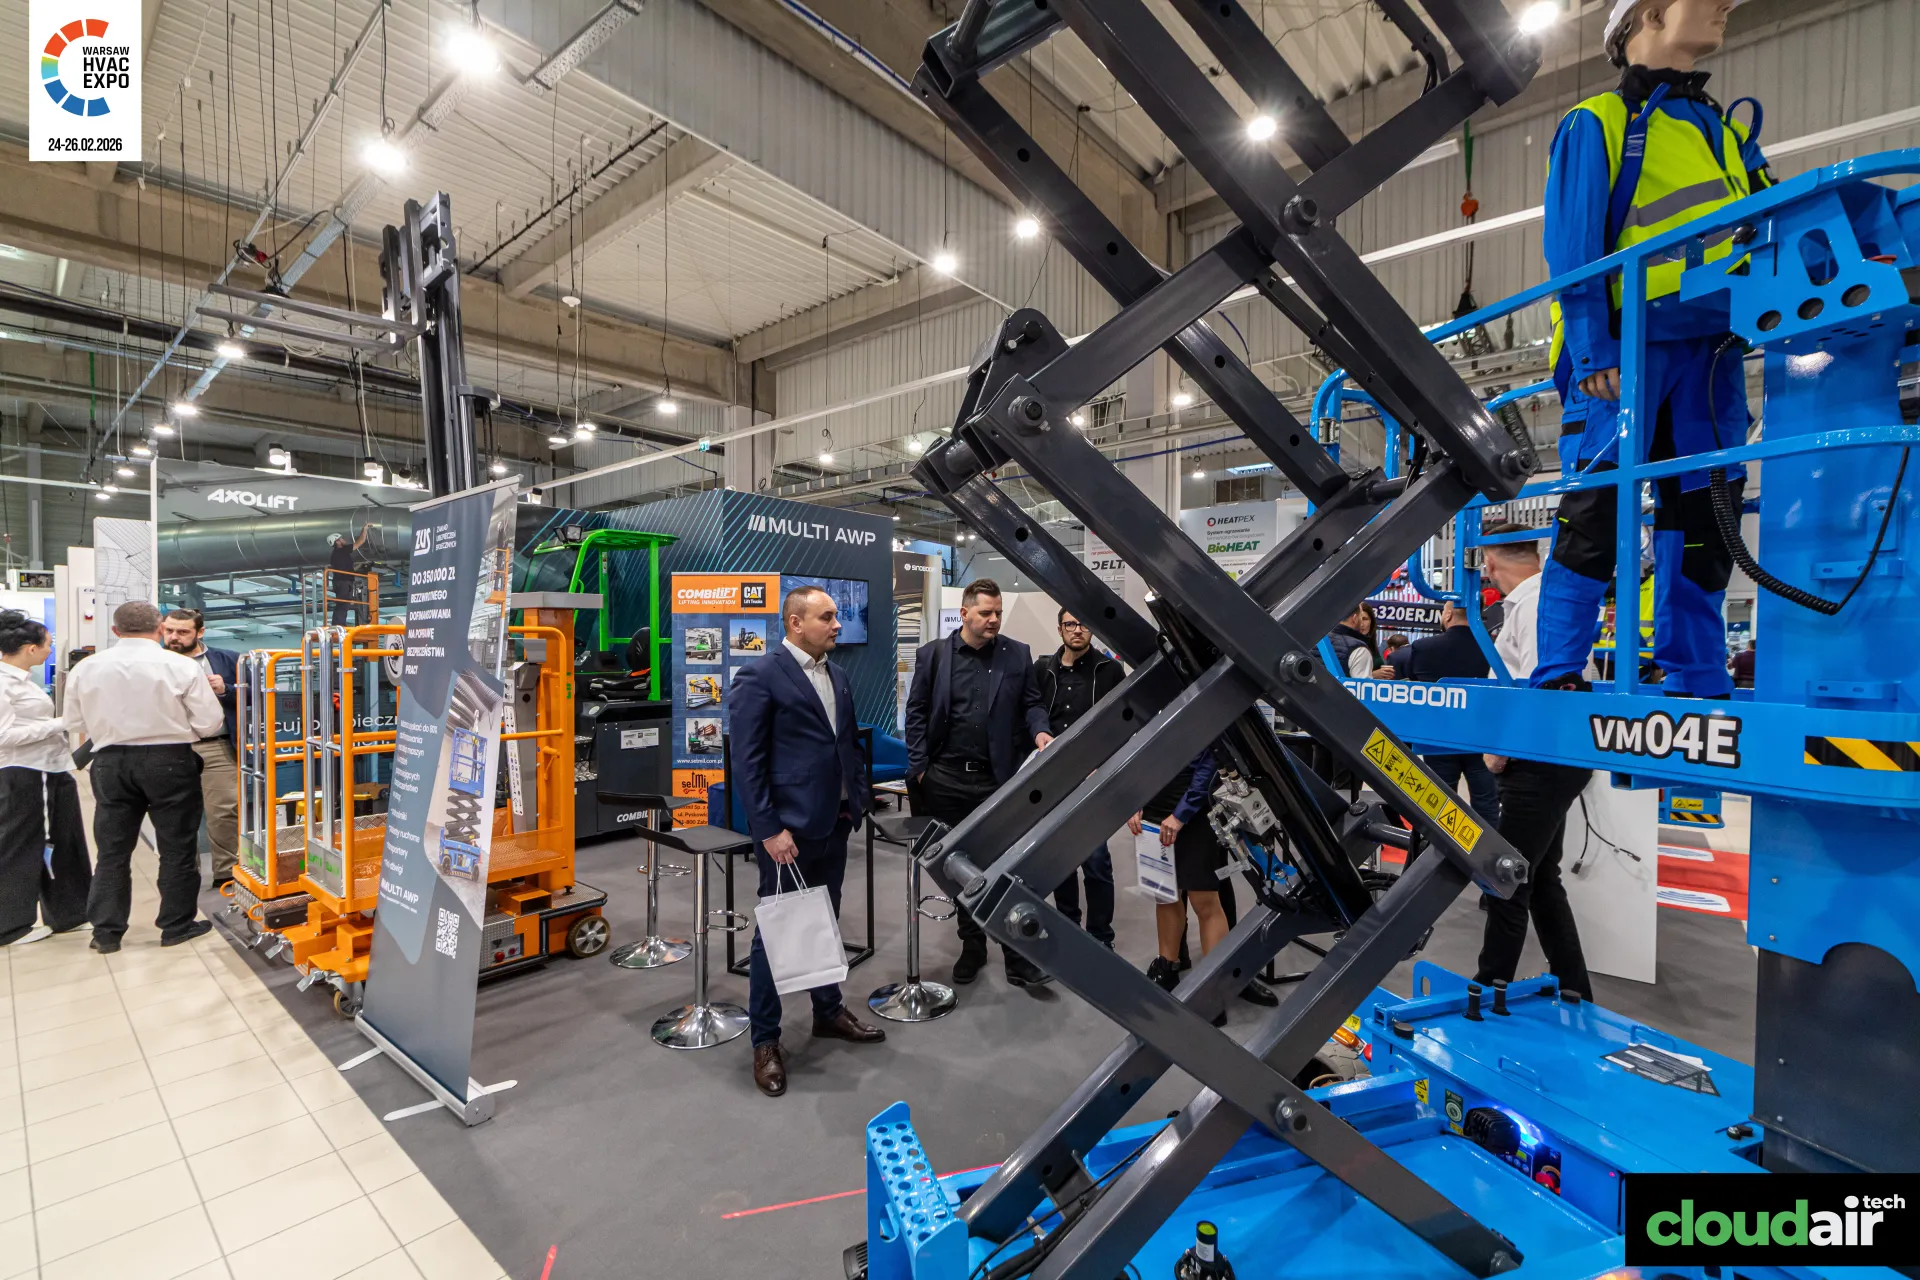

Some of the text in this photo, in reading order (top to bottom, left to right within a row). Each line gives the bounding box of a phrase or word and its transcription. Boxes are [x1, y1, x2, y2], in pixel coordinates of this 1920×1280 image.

[207, 488, 299, 511] AXOLIFT
[1213, 514, 1256, 525] HEATPEX
[768, 516, 876, 546] MULTI AWP
[413, 527, 431, 557] ZUS
[1207, 541, 1261, 554] BioHEAT
[411, 571, 422, 586] DO
[743, 586, 763, 599] CAT
[1592, 712, 1739, 766] VM04E
[616, 809, 649, 823] COMBIL
[403, 889, 419, 904] AWP
